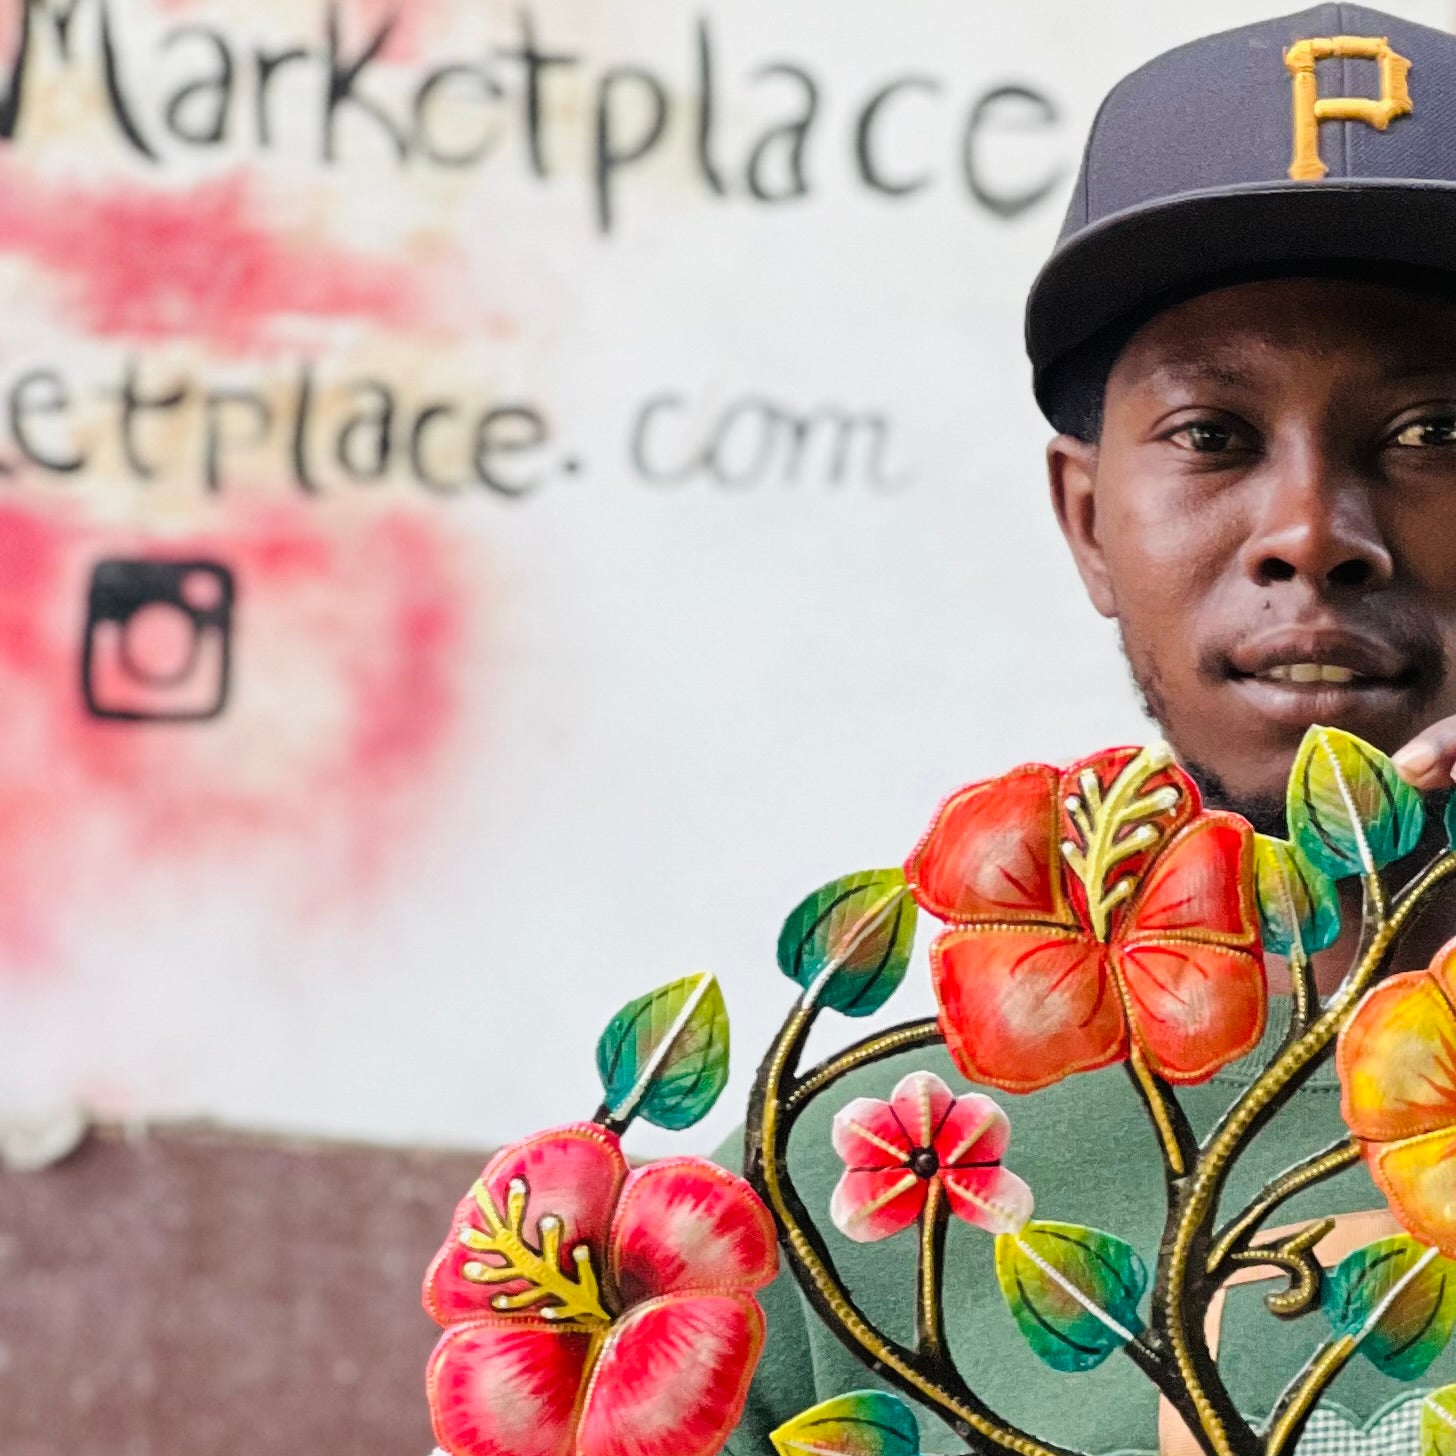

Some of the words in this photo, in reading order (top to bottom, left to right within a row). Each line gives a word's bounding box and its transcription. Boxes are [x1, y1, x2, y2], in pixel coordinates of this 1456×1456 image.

[0, 0, 1070, 232] Marketplace
[1284, 36, 1412, 180] P
[0, 354, 582, 500] etplace.
